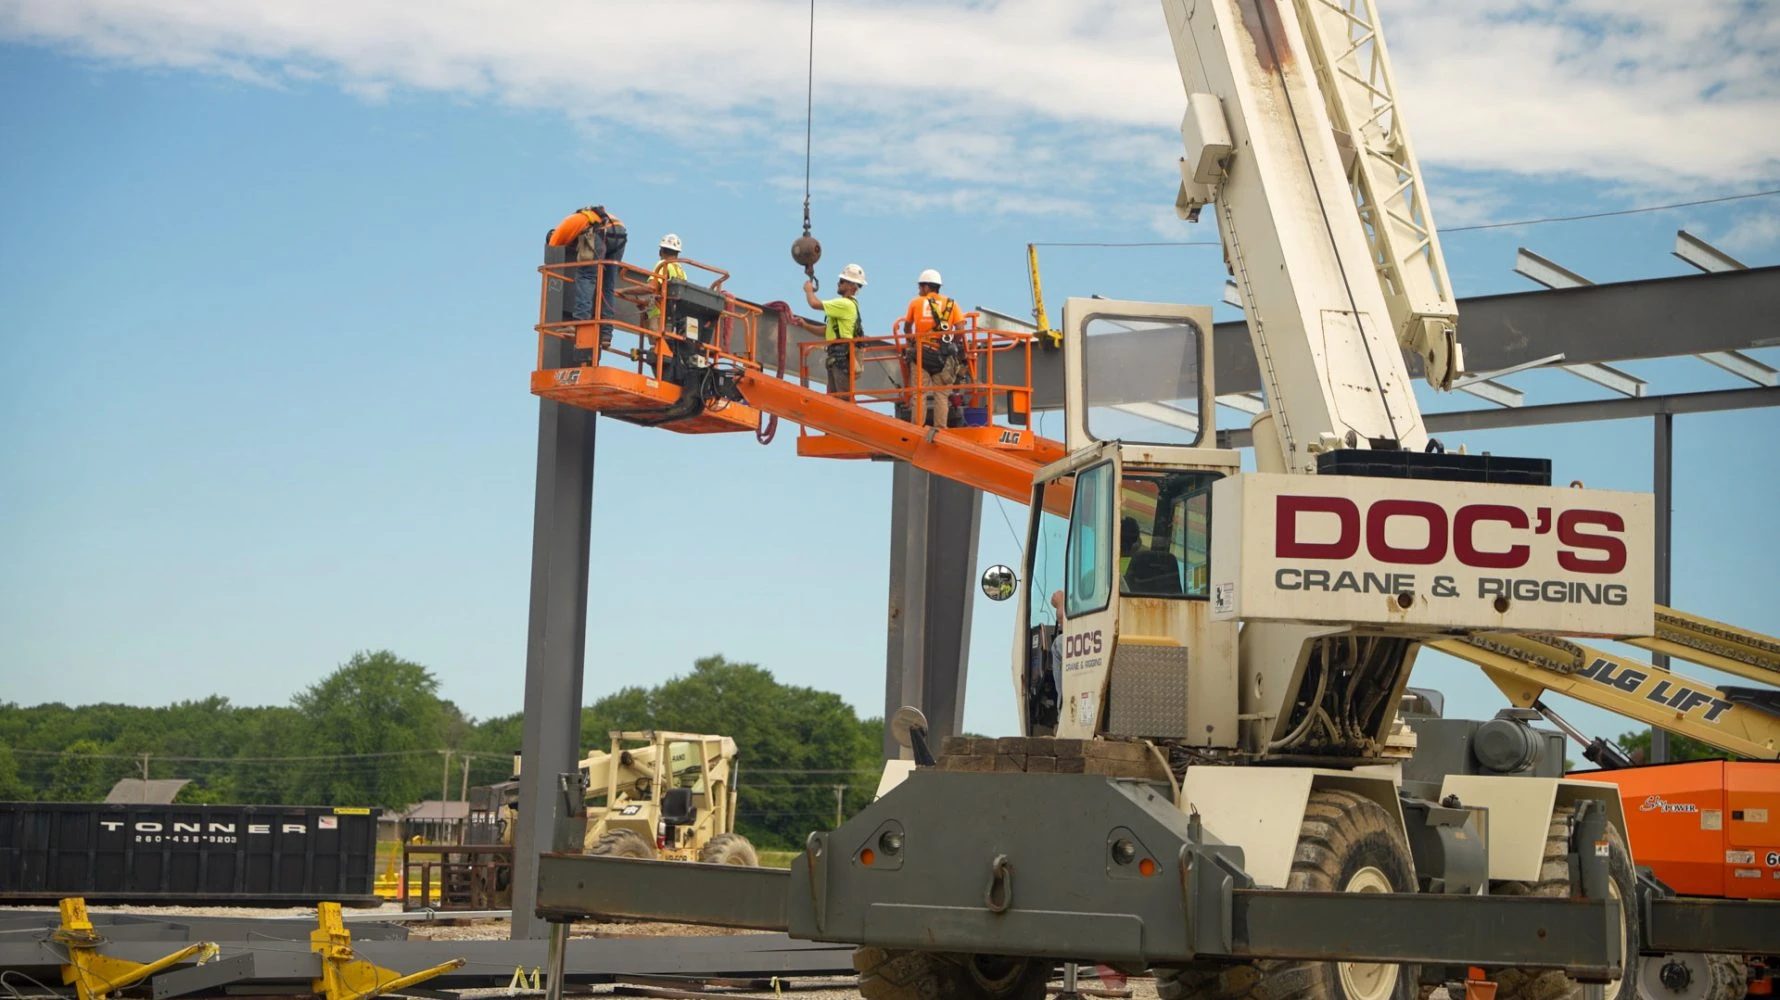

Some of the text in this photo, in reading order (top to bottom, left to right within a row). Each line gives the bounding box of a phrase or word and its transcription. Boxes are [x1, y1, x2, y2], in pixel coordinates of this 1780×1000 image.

[999, 431, 1020, 444] JLG
[1275, 494, 1627, 575] DOC'S
[1275, 568, 1628, 606] CRANE & RIGGING
[1066, 630, 1102, 659] DOC'S
[1575, 658, 1734, 721] JLG LIFT
[100, 821, 306, 834] TONNER
[1766, 851, 1780, 867] 6
